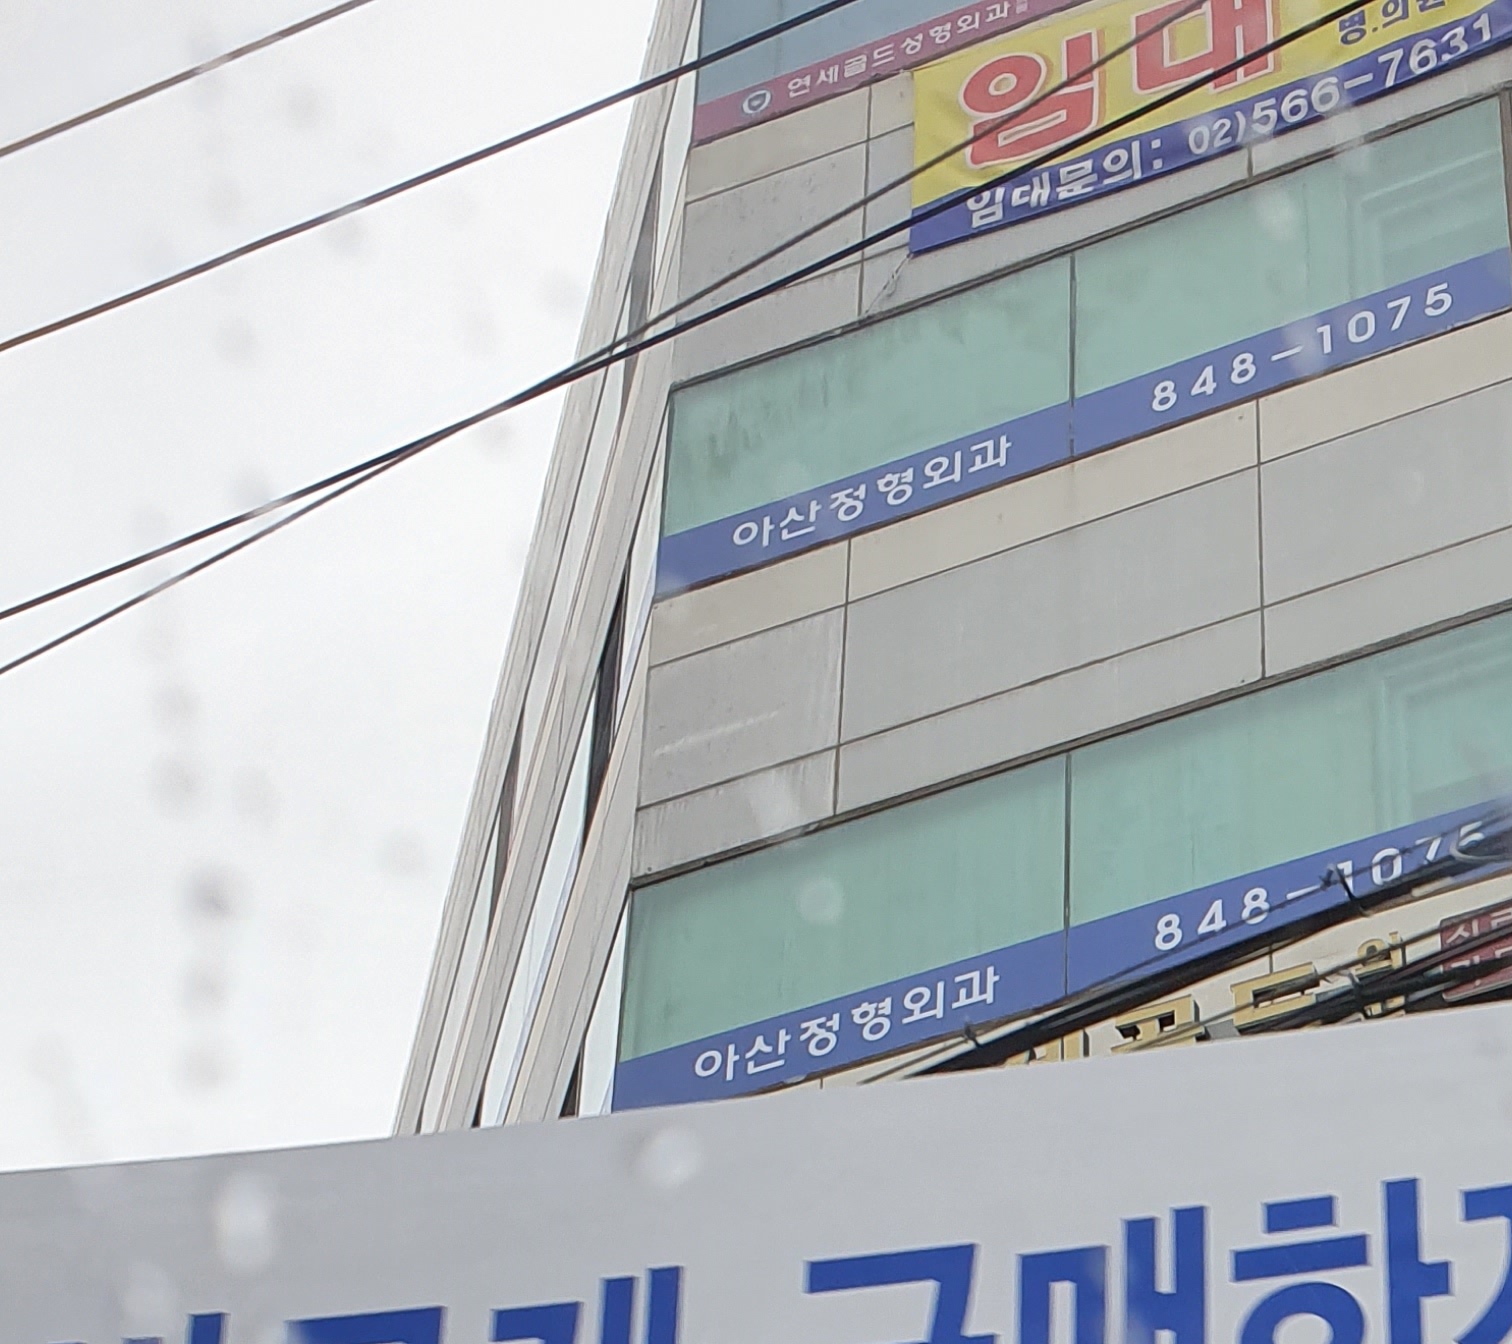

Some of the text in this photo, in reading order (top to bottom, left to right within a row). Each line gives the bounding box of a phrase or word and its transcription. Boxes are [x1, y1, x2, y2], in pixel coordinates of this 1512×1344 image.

[958, 0, 1274, 169] 임대
[1189, 13, 1493, 157] 02)566-7631
[733, 283, 1455, 549] 아산정형외과 848-1075
[694, 967, 1000, 1081] 아산정형외과
[1153, 821, 1486, 952] 848-1075
